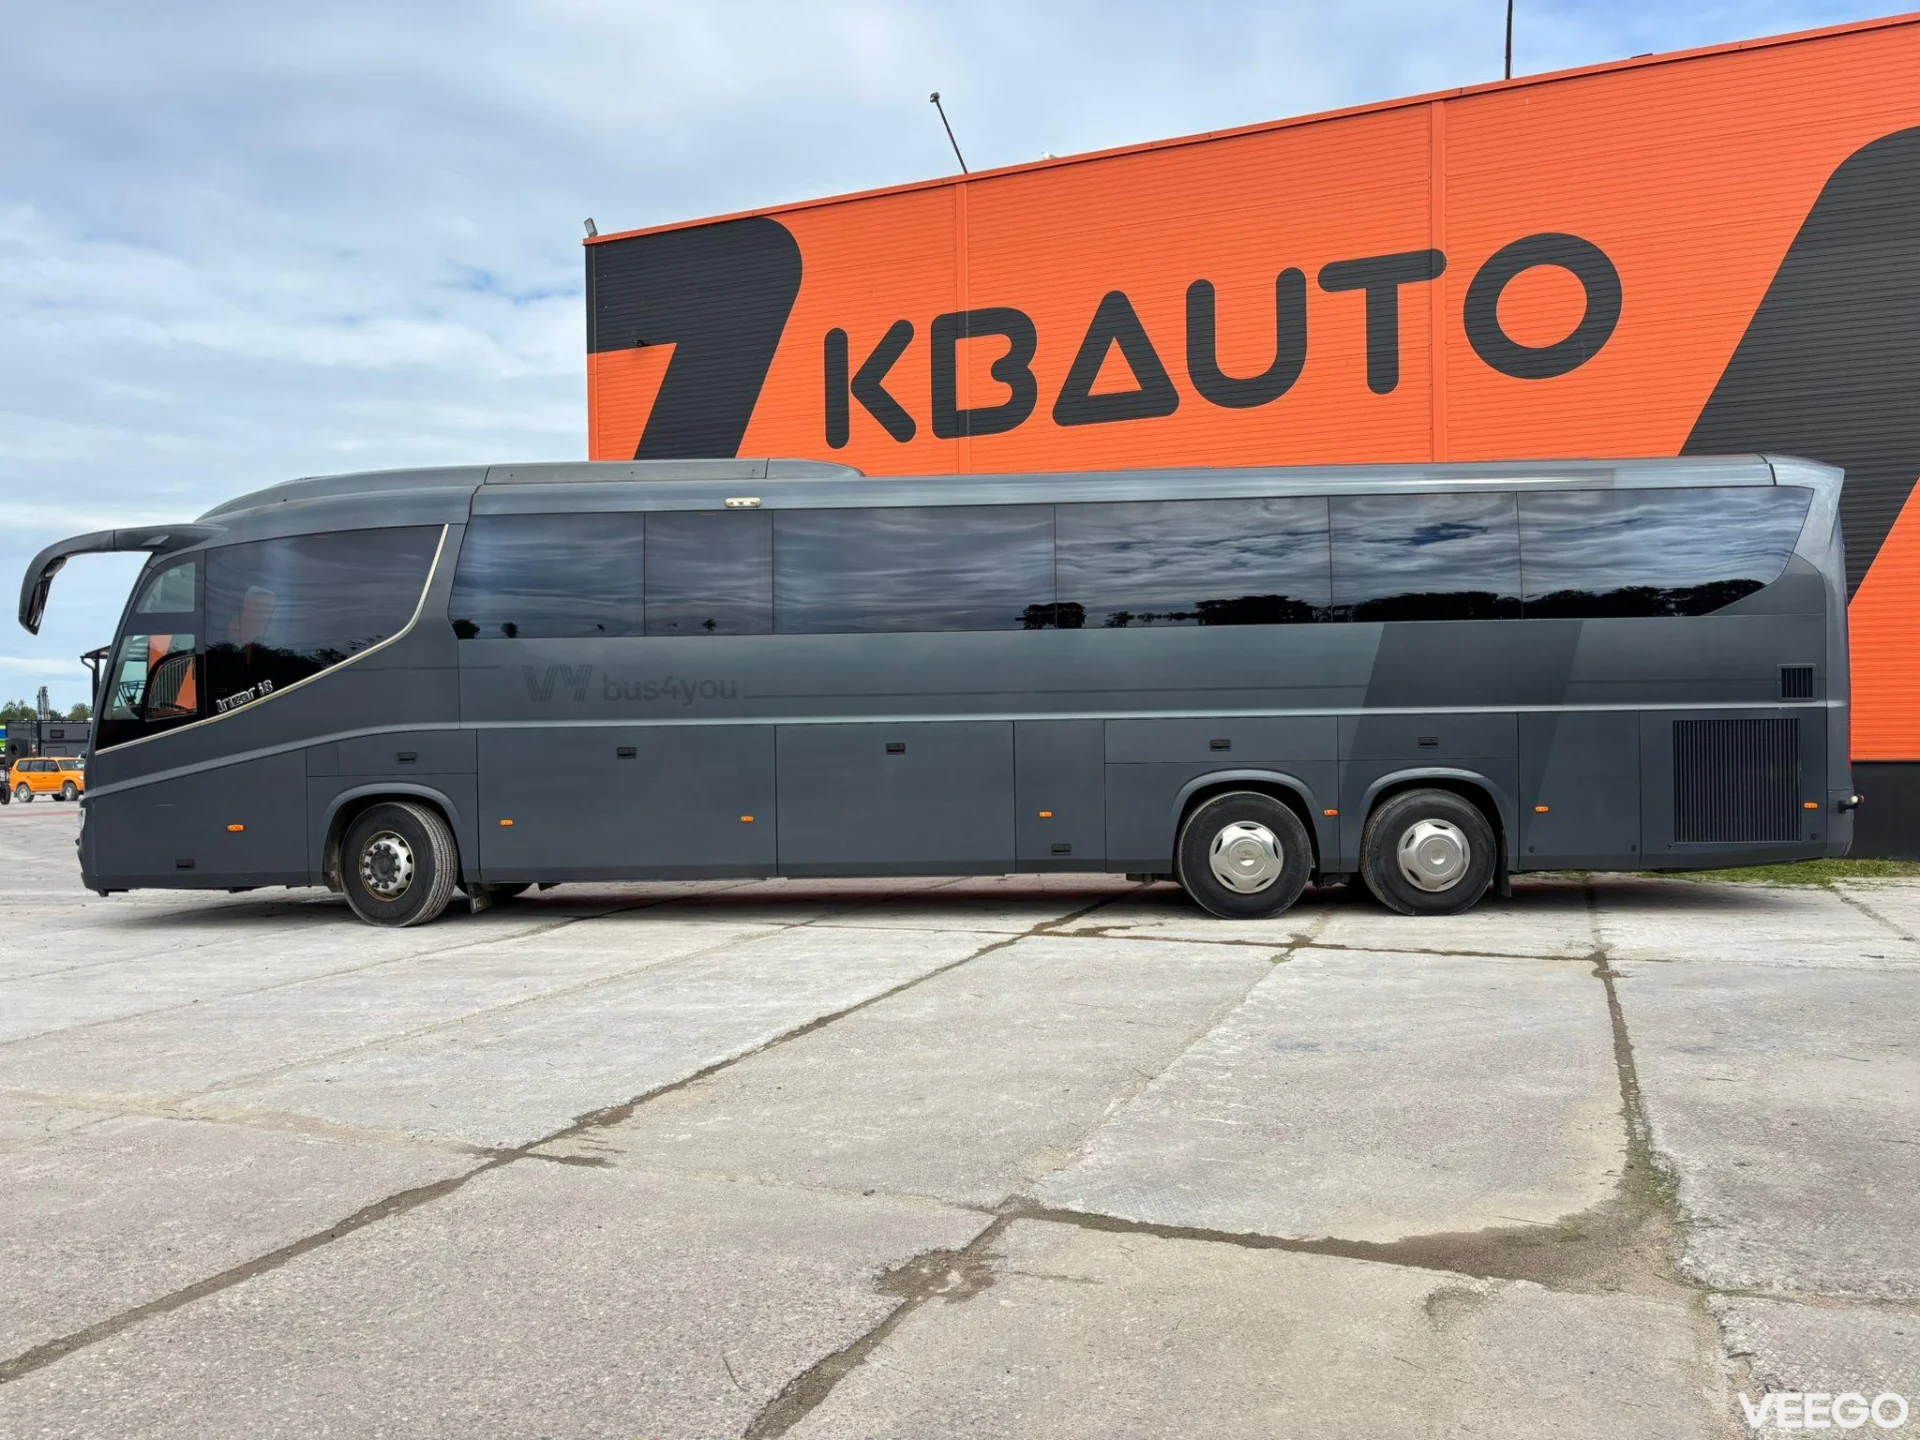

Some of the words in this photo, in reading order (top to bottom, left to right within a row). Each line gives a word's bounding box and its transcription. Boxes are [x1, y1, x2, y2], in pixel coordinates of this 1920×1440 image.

[824, 232, 1622, 449] KBAUTO
[520, 664, 593, 702] VY
[602, 674, 738, 706] bus4you
